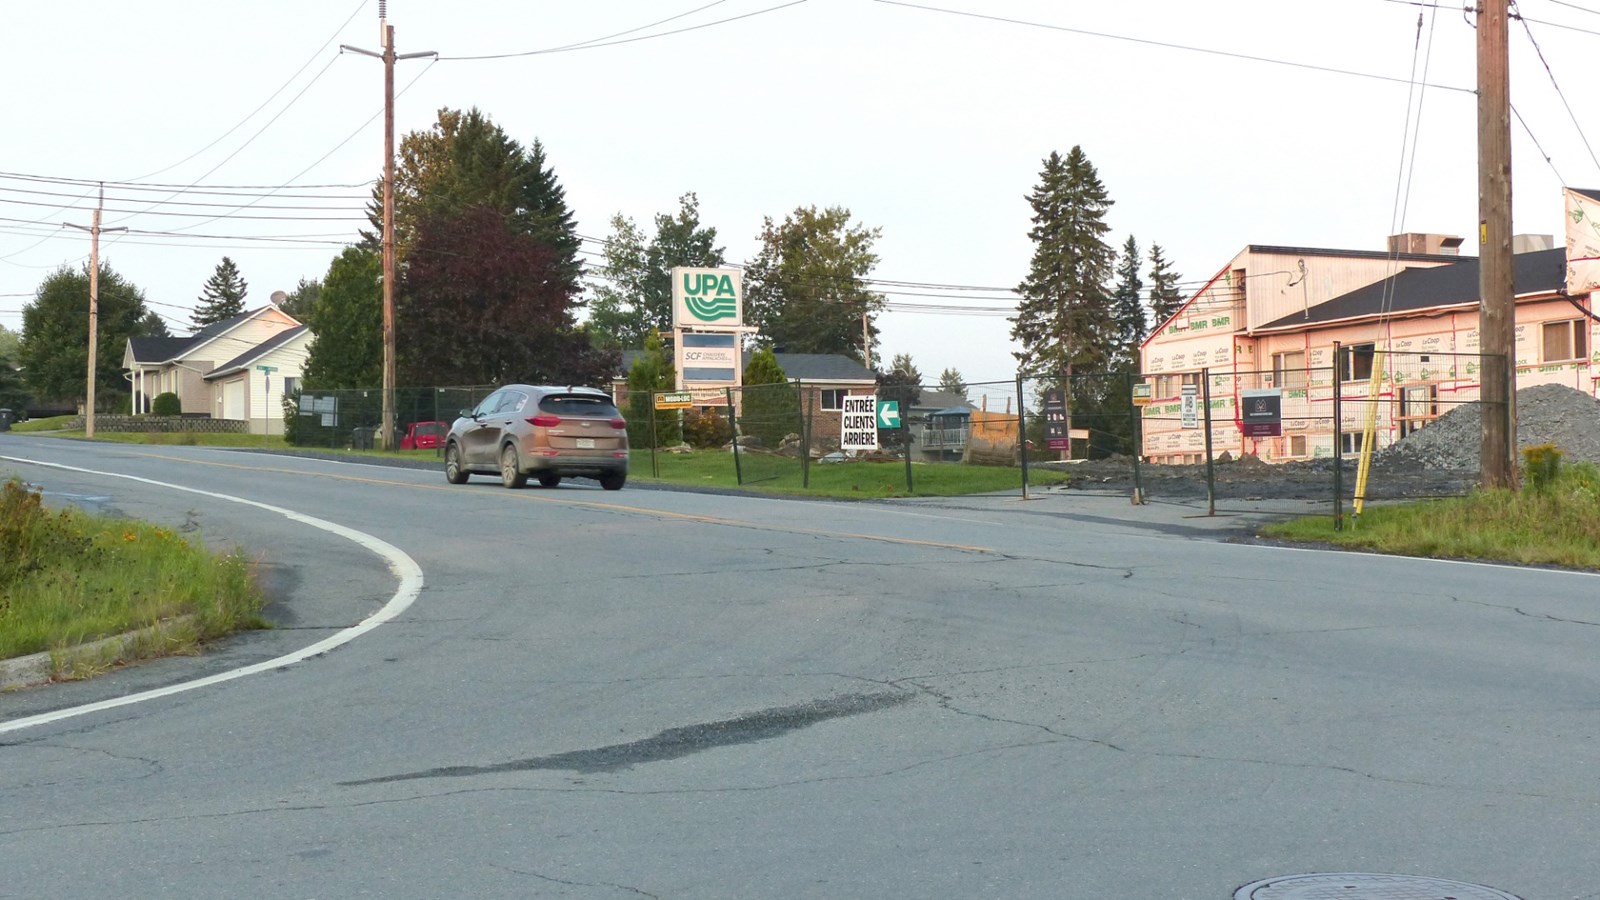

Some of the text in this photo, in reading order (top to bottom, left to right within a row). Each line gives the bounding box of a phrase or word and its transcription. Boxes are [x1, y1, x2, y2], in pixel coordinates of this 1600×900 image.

[684, 273, 736, 296] UPA
[1190, 320, 1208, 330] BMR
[1212, 317, 1230, 327] BMR
[685, 352, 702, 360] SCF
[845, 396, 874, 412] ENTRÉE
[844, 416, 875, 429] CLIENTS
[843, 429, 875, 445] ARRIÈRE
